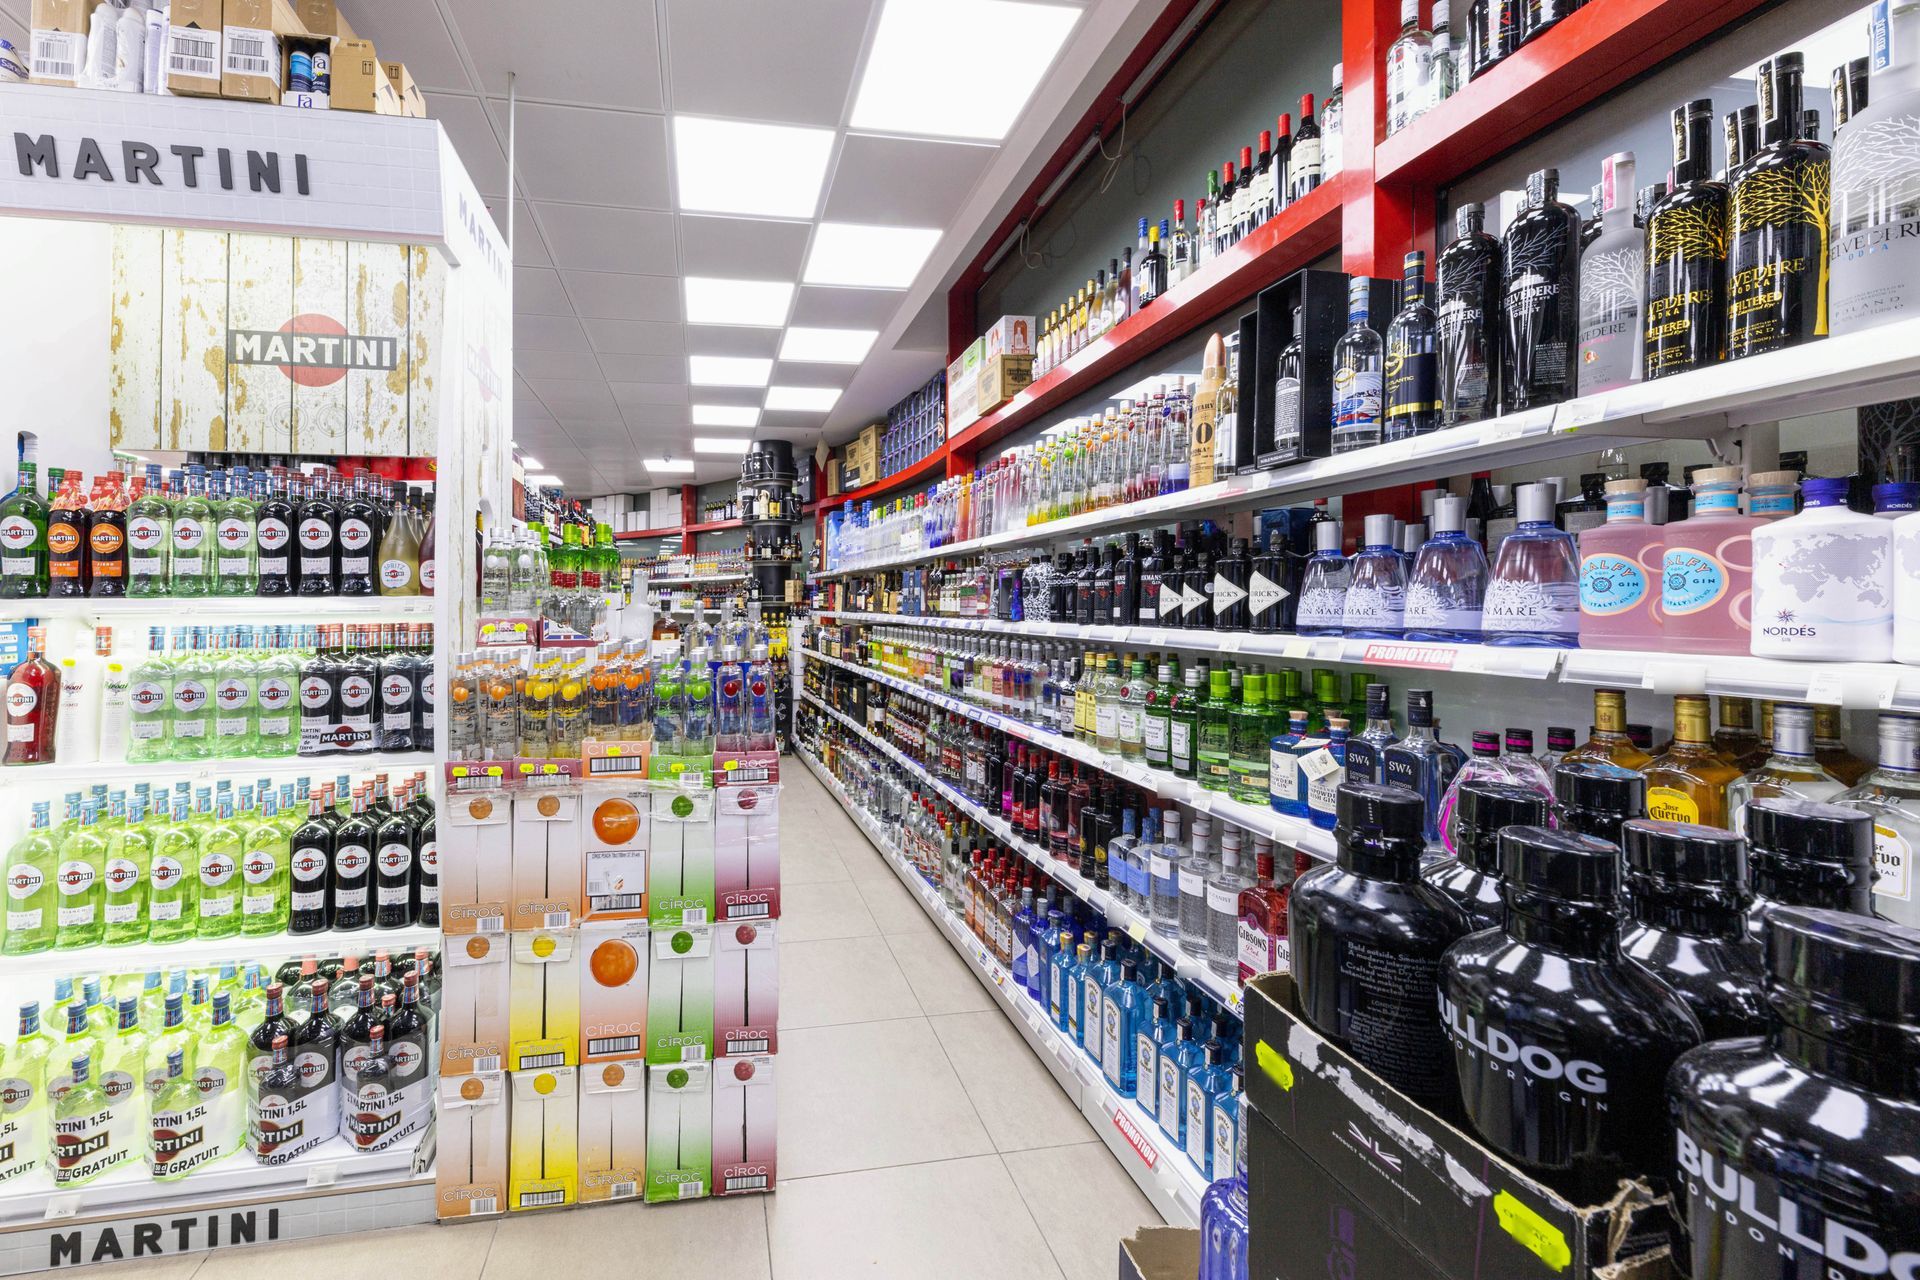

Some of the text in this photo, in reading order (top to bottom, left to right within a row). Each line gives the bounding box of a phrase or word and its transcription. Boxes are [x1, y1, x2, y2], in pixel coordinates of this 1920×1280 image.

[313, 55, 326, 70] Fa
[14, 132, 310, 196] MARTINI
[459, 192, 507, 290] MARTINI
[1848, 242, 1889, 261] ODKA
[236, 333, 392, 369] MARTINI
[1, 529, 34, 537] MARTINI
[130, 529, 160, 537] MARTINI
[1408, 606, 1428, 615] ARE
[1492, 605, 1538, 616] MARE
[1763, 624, 1816, 637] NORDÉS
[1366, 645, 1455, 664] PROMOTION
[132, 693, 163, 701] MARTINI
[175, 692, 205, 700] MARTINI
[217, 690, 248, 698] MARTINI
[259, 690, 290, 698] MARTINI
[301, 688, 329, 696] MARTINI
[1349, 752, 1370, 766] SW4
[1388, 761, 1413, 776] SW4
[1650, 806, 1691, 823] Cuervo
[294, 860, 324, 868] MARTINI
[337, 857, 367, 865] MARTINI
[380, 855, 408, 863] MARTINI
[152, 868, 181, 877] MARTINI
[201, 865, 233, 874] MARTINI
[244, 863, 273, 871] MARTINI
[8, 876, 41, 885] MARTINI
[59, 872, 93, 882] MARTINI
[106, 871, 137, 879] MARTINI
[393, 1052, 419, 1063] ARTINI
[300, 1063, 325, 1074] ARTINI
[103, 1081, 132, 1094] ARTINI
[197, 1078, 224, 1089] ARTINI
[1490, 1061, 1608, 1112] DRY GIN
[0, 1089, 30, 1099] ARTINI
[287, 1100, 308, 1116] 1,5L
[56, 1110, 114, 1133] RTINI 1,5L
[153, 1105, 208, 1128] RTINI 1,5L
[155, 1130, 200, 1152] RTINI
[1115, 1111, 1158, 1167] PROMOTION
[57, 1135, 105, 1158] RTINI
[270, 1137, 320, 1165] GRATUIT
[72, 1149, 128, 1179] GRATUIT
[169, 1146, 220, 1174] GRATUIT
[0, 1160, 36, 1181] ATUIT
[1367, 1160, 1390, 1181] UNITED
[1390, 1179, 1422, 1206] KINGDOM
[1676, 1127, 1920, 1280] BULLD
[1678, 1170, 1794, 1261] LONDON
[50, 1208, 280, 1267] MARTINI
